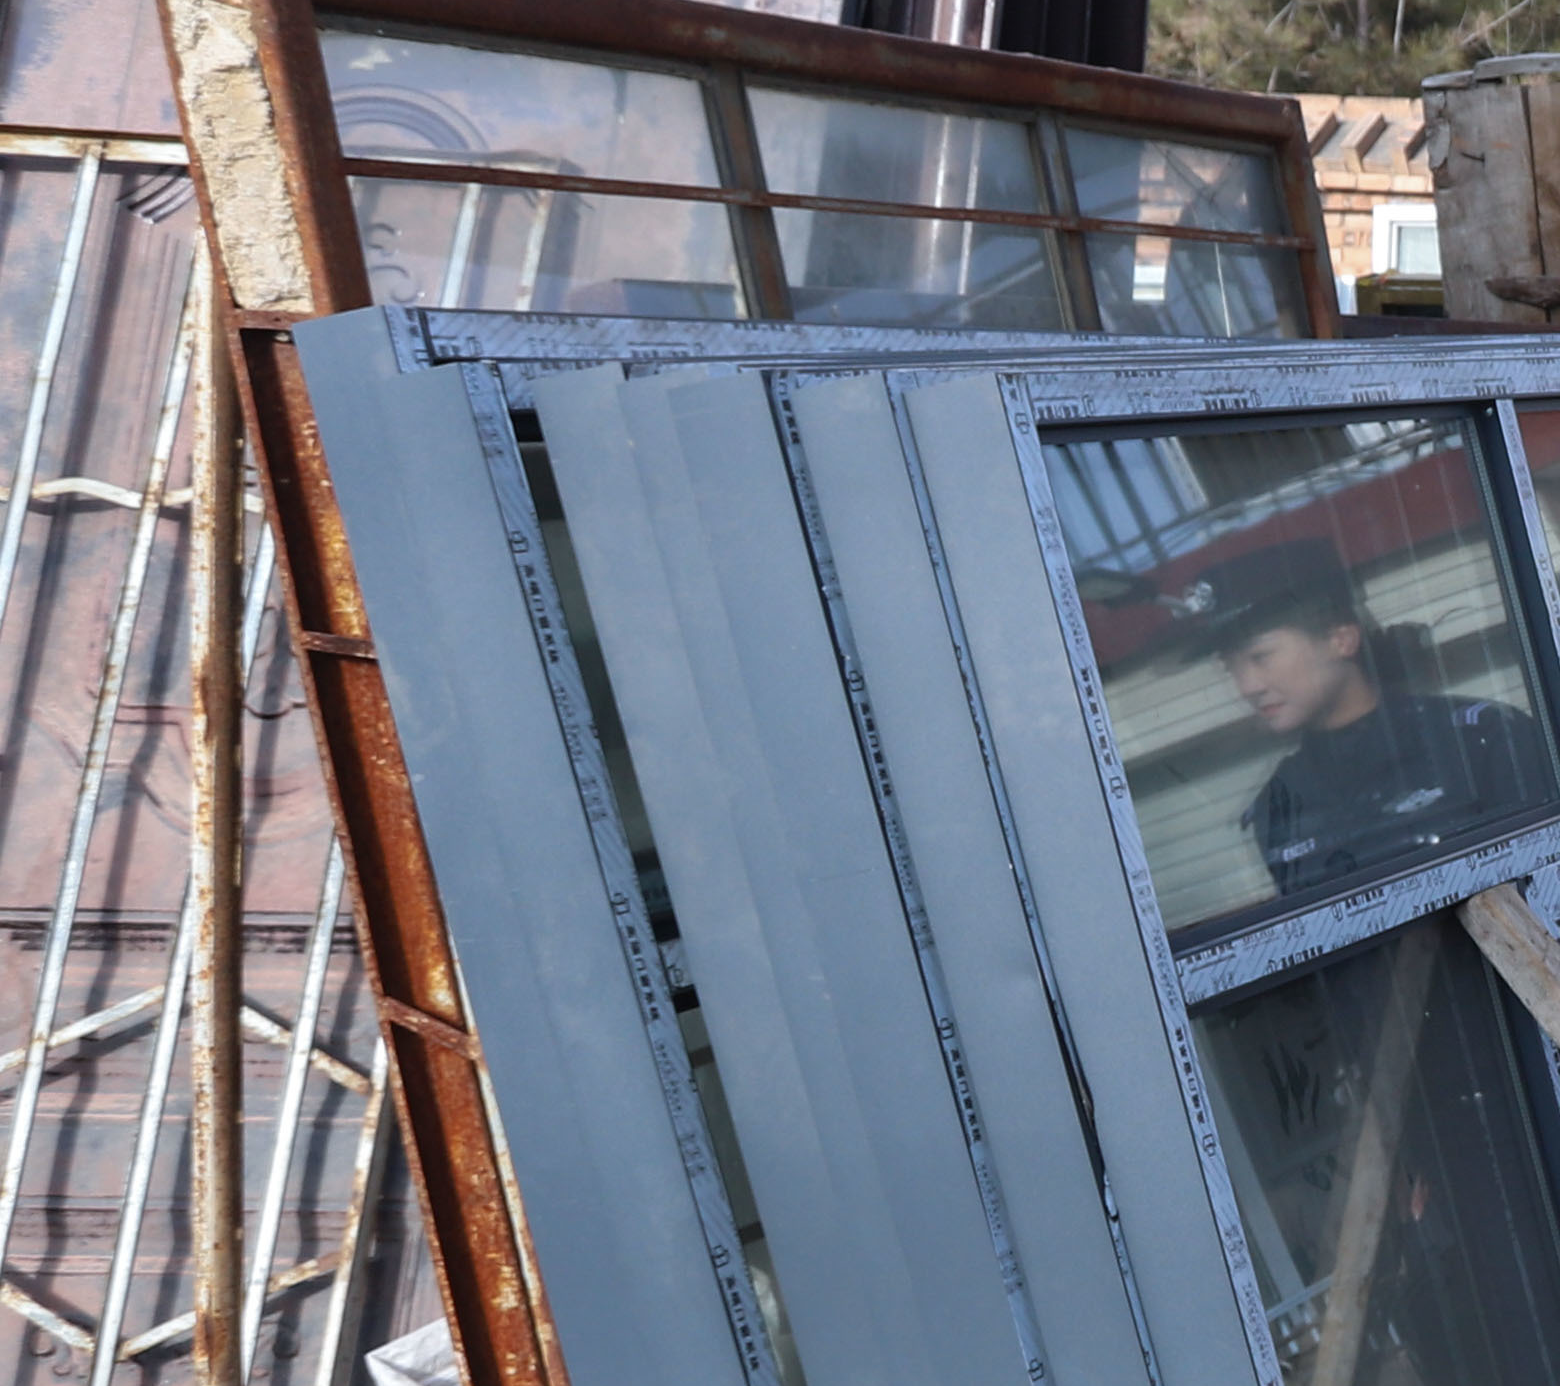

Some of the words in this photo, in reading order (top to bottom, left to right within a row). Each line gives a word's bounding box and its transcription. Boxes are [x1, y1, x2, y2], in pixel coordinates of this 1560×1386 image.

[518, 562, 565, 664] 高端门窗系统
[858, 701, 892, 797] 高端门窗系统
[1078, 666, 1114, 767] 高端门窗系统
[625, 924, 660, 1023] 高端门窗系统
[948, 1047, 983, 1143] 高端门窗系统
[1172, 1026, 1207, 1125] 高端门窗系统
